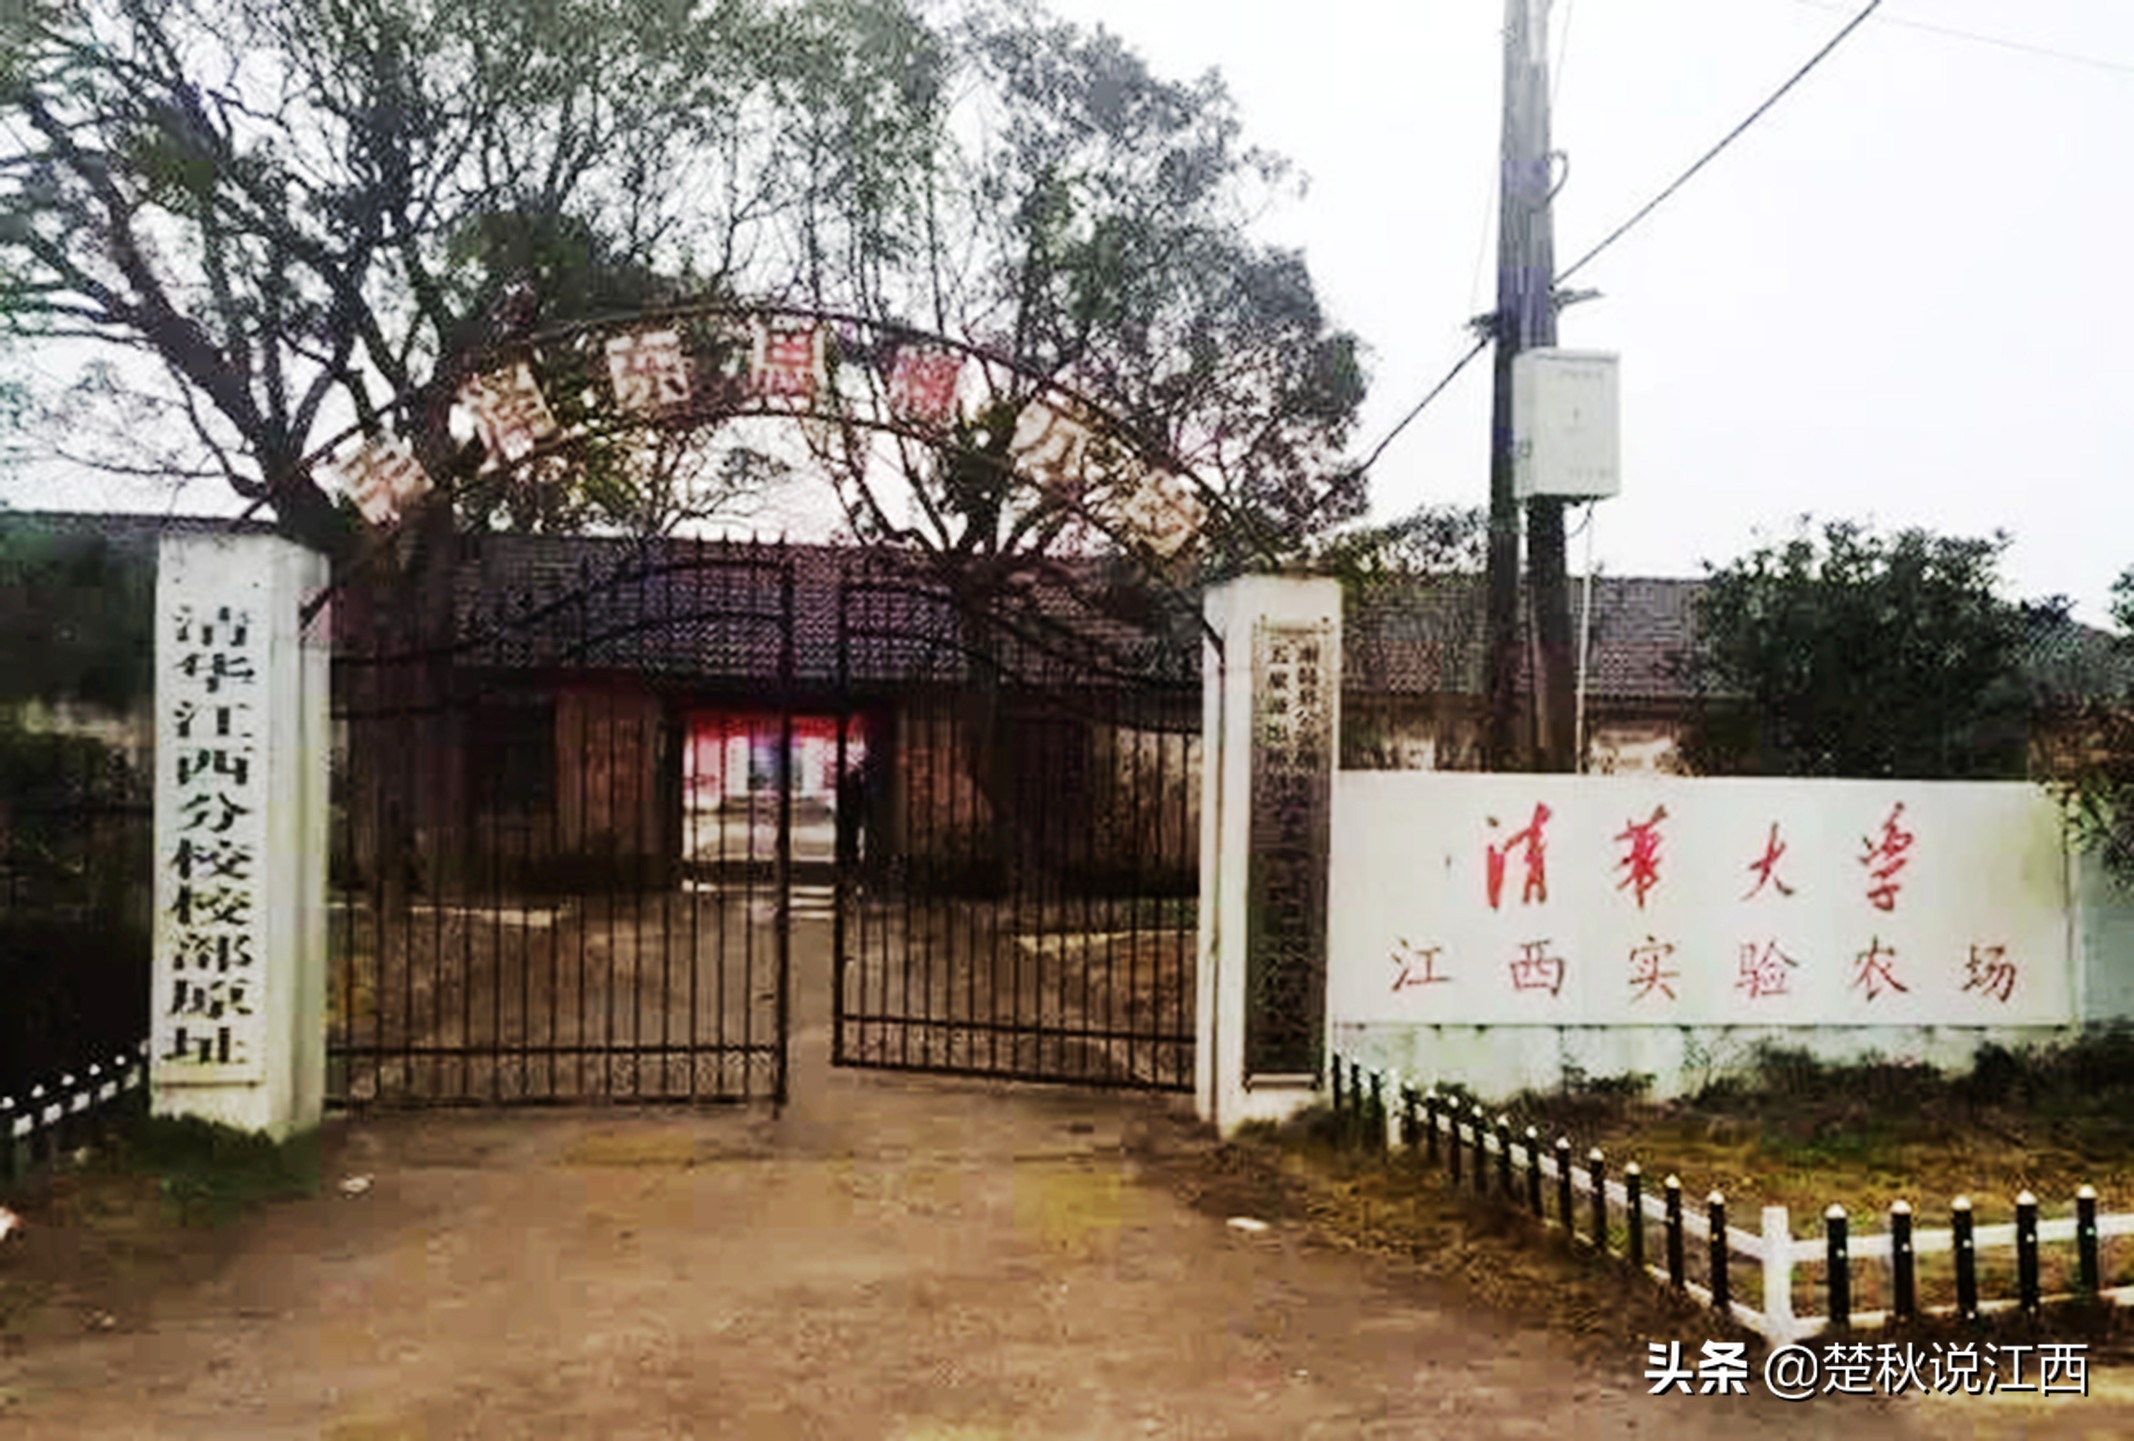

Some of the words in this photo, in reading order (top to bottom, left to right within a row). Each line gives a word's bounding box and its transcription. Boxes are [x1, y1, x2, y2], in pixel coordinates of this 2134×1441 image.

[162, 605, 258, 1067] 清华江西分校校部原址
[1392, 935, 2018, 1003] 江西实验农场
